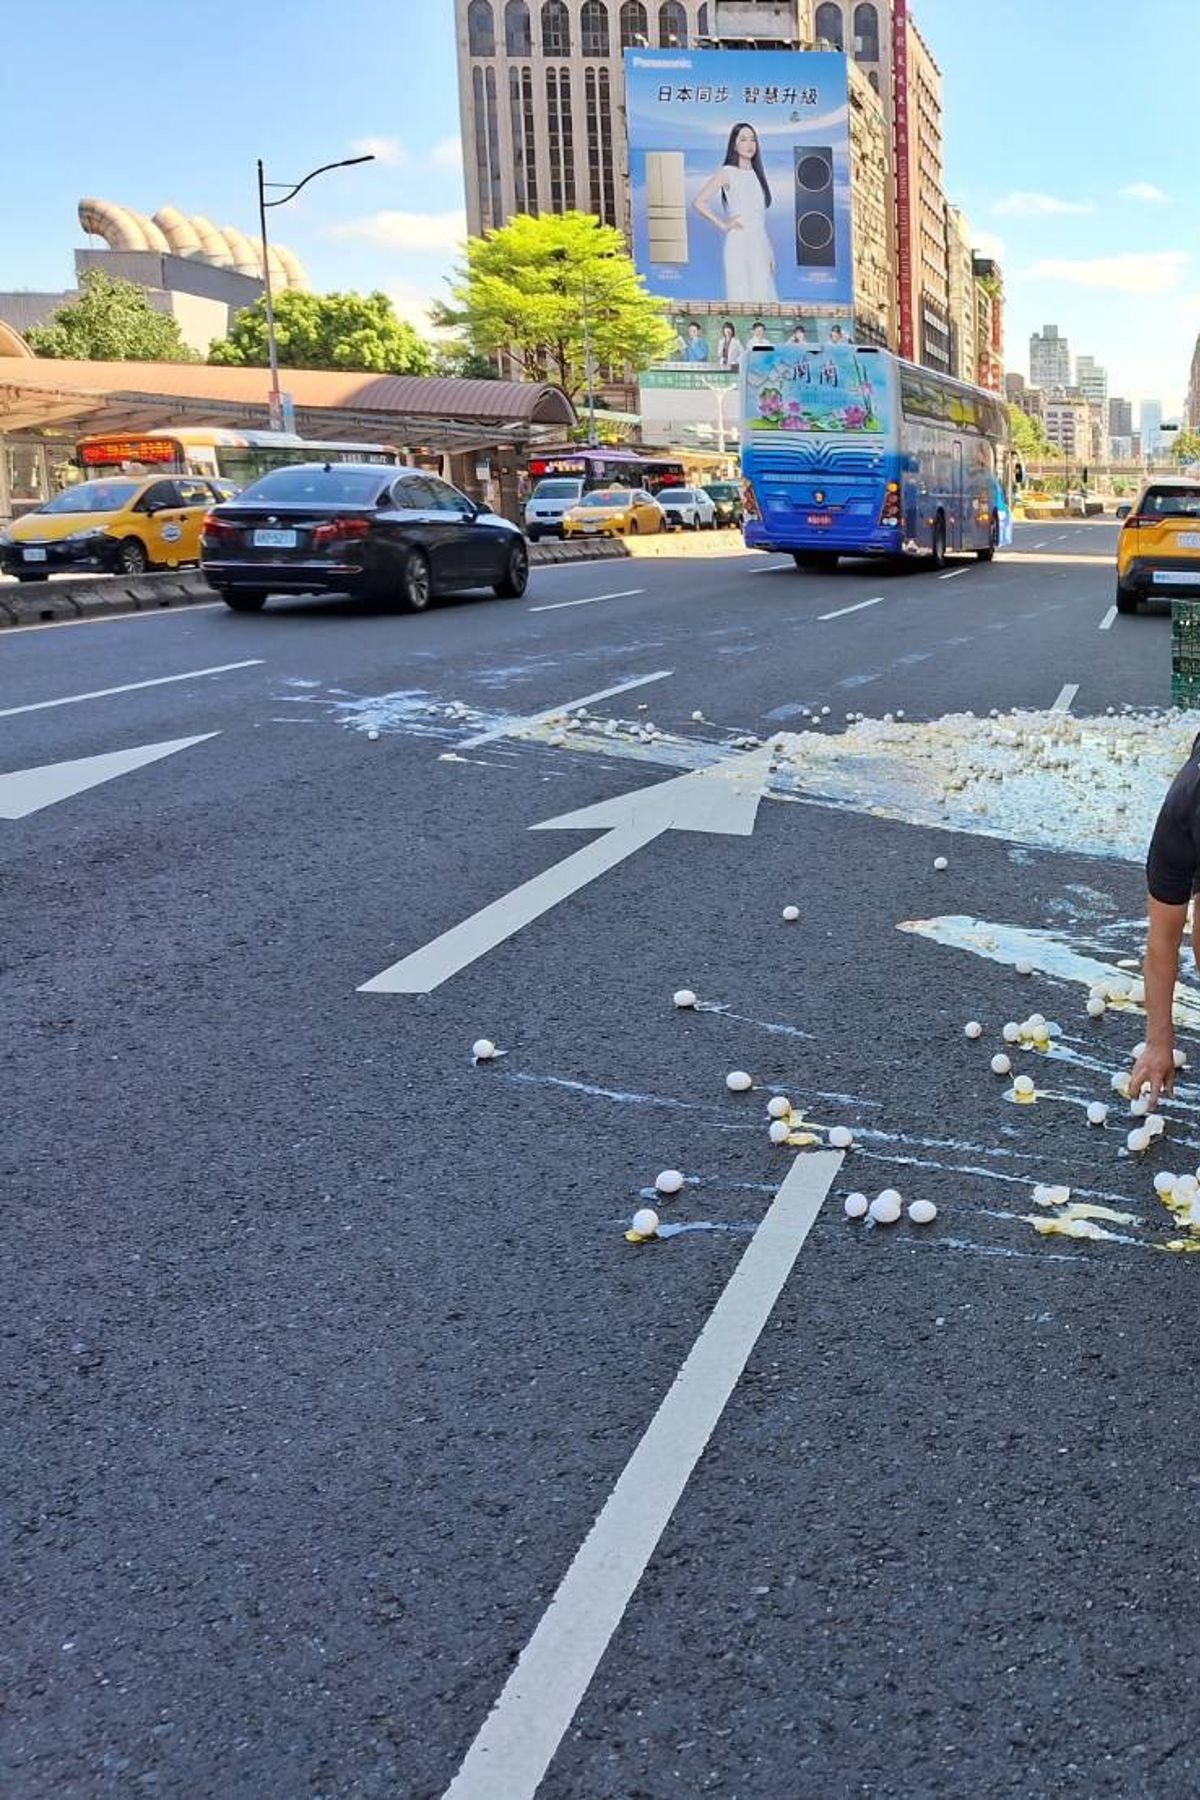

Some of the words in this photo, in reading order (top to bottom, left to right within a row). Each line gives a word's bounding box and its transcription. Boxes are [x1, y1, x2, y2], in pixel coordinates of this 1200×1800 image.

[658, 85, 729, 104] 日本同步
[743, 86, 818, 105] 智慧升級
